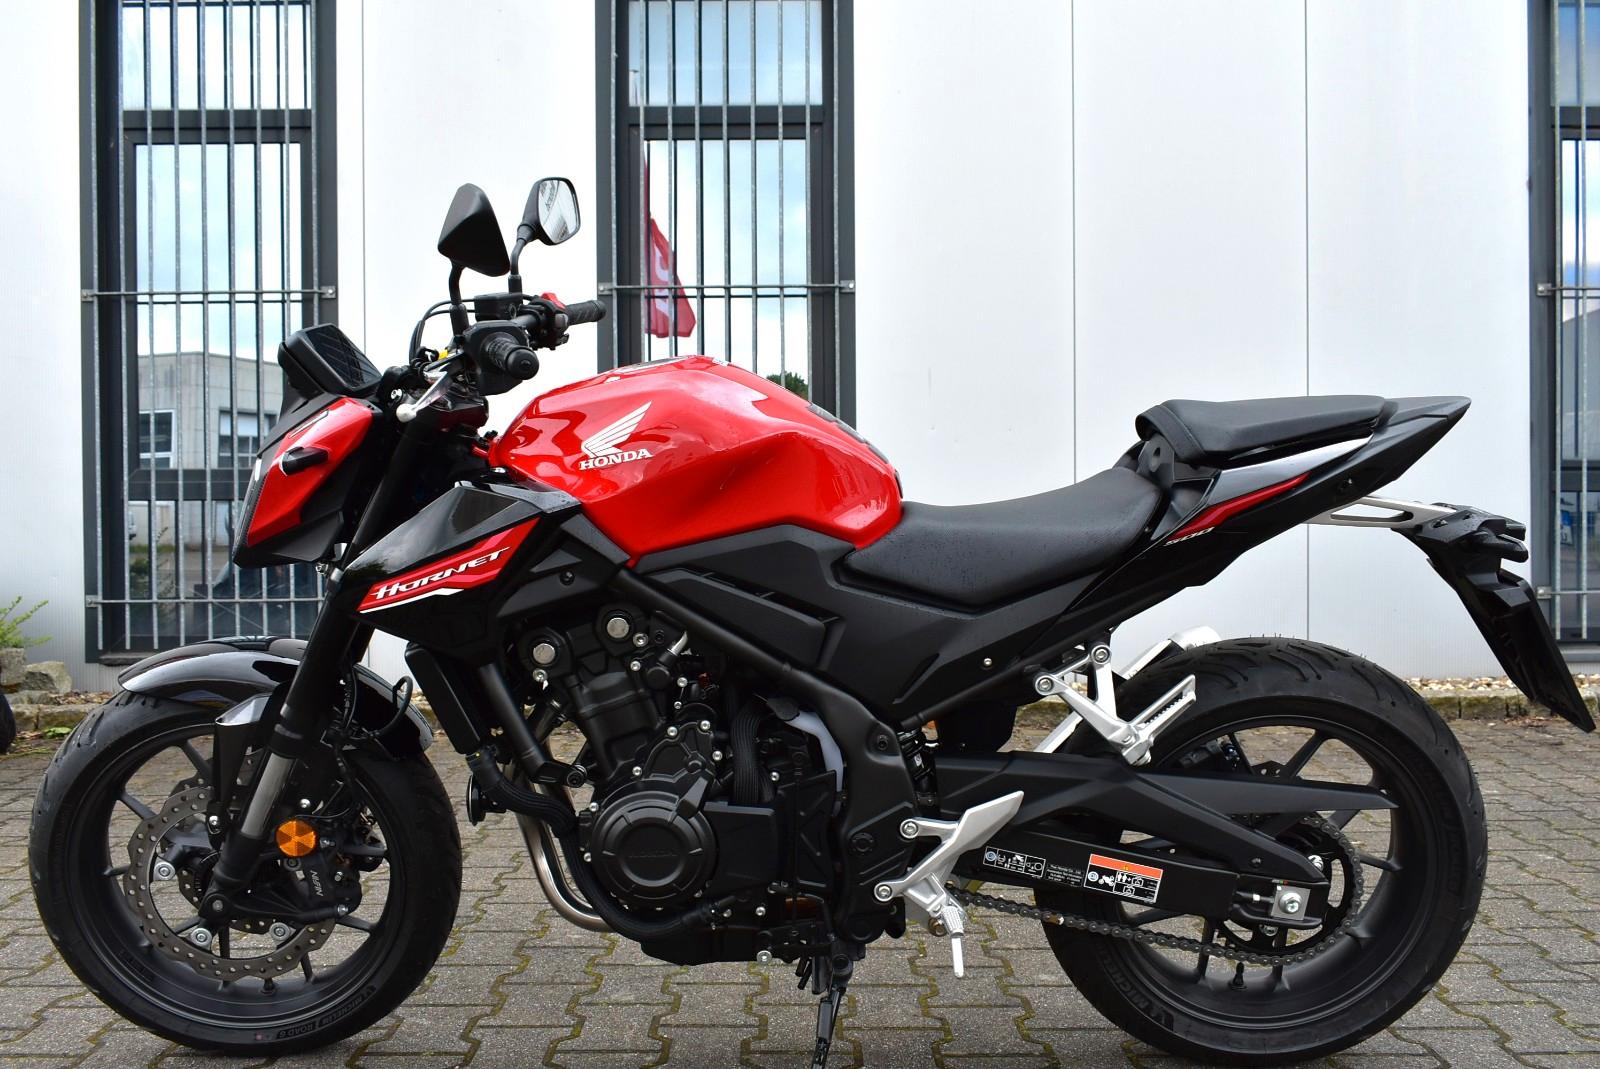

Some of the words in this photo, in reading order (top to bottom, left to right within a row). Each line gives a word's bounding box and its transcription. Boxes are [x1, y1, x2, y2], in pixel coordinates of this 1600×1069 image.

[579, 448, 655, 470] HONDA
[370, 546, 510, 600] HORNET
[287, 1024, 314, 1036] ROAD
